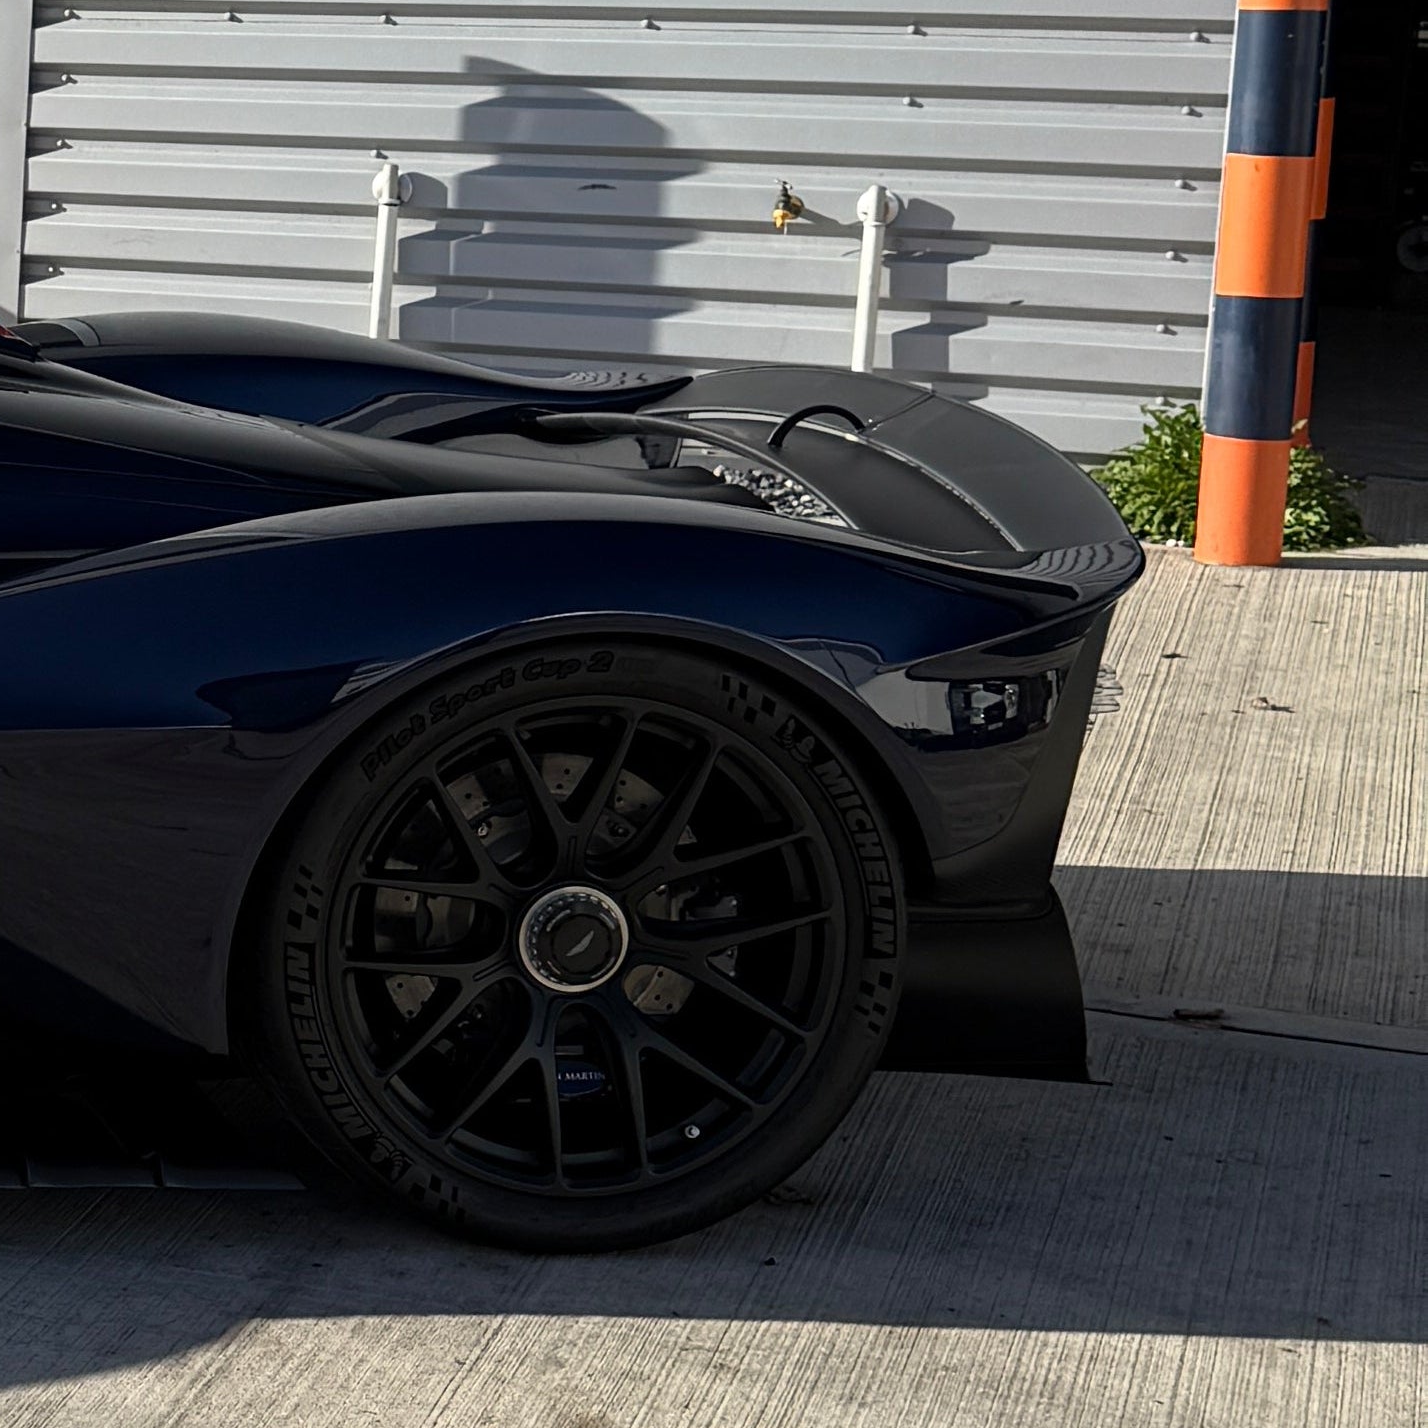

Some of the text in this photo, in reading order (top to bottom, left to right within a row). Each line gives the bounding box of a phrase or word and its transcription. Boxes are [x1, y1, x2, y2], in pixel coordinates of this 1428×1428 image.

[359, 713, 426, 781] Pilot
[429, 667, 516, 722] Sport
[522, 658, 582, 681] Cup
[586, 650, 615, 673] 2
[811, 758, 895, 957] MICHELIN
[286, 944, 375, 1140] MICHELIN
